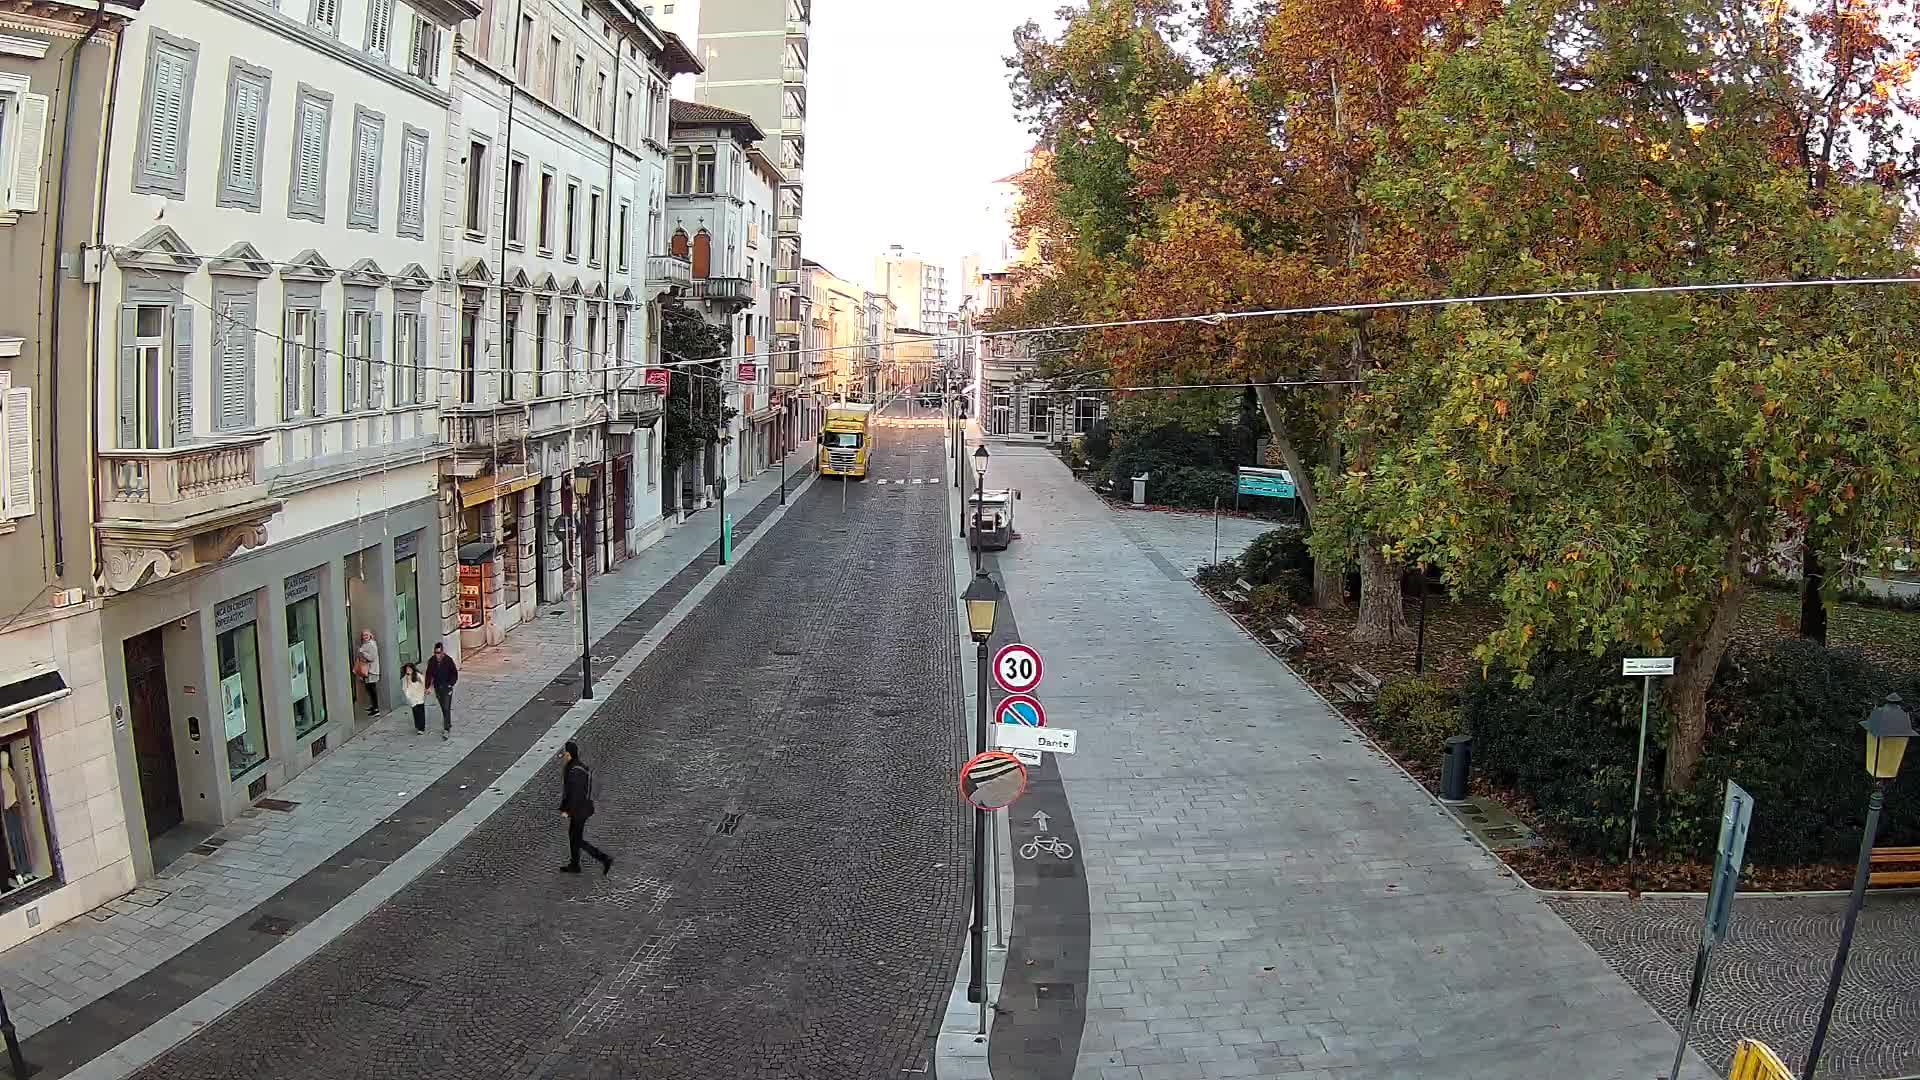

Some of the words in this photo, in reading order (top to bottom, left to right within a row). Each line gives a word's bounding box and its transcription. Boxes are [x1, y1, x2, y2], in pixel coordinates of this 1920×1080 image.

[216, 610, 244, 627] OPERATIVO
[1005, 657, 1032, 679] 30
[1038, 737, 1069, 748] Dante
